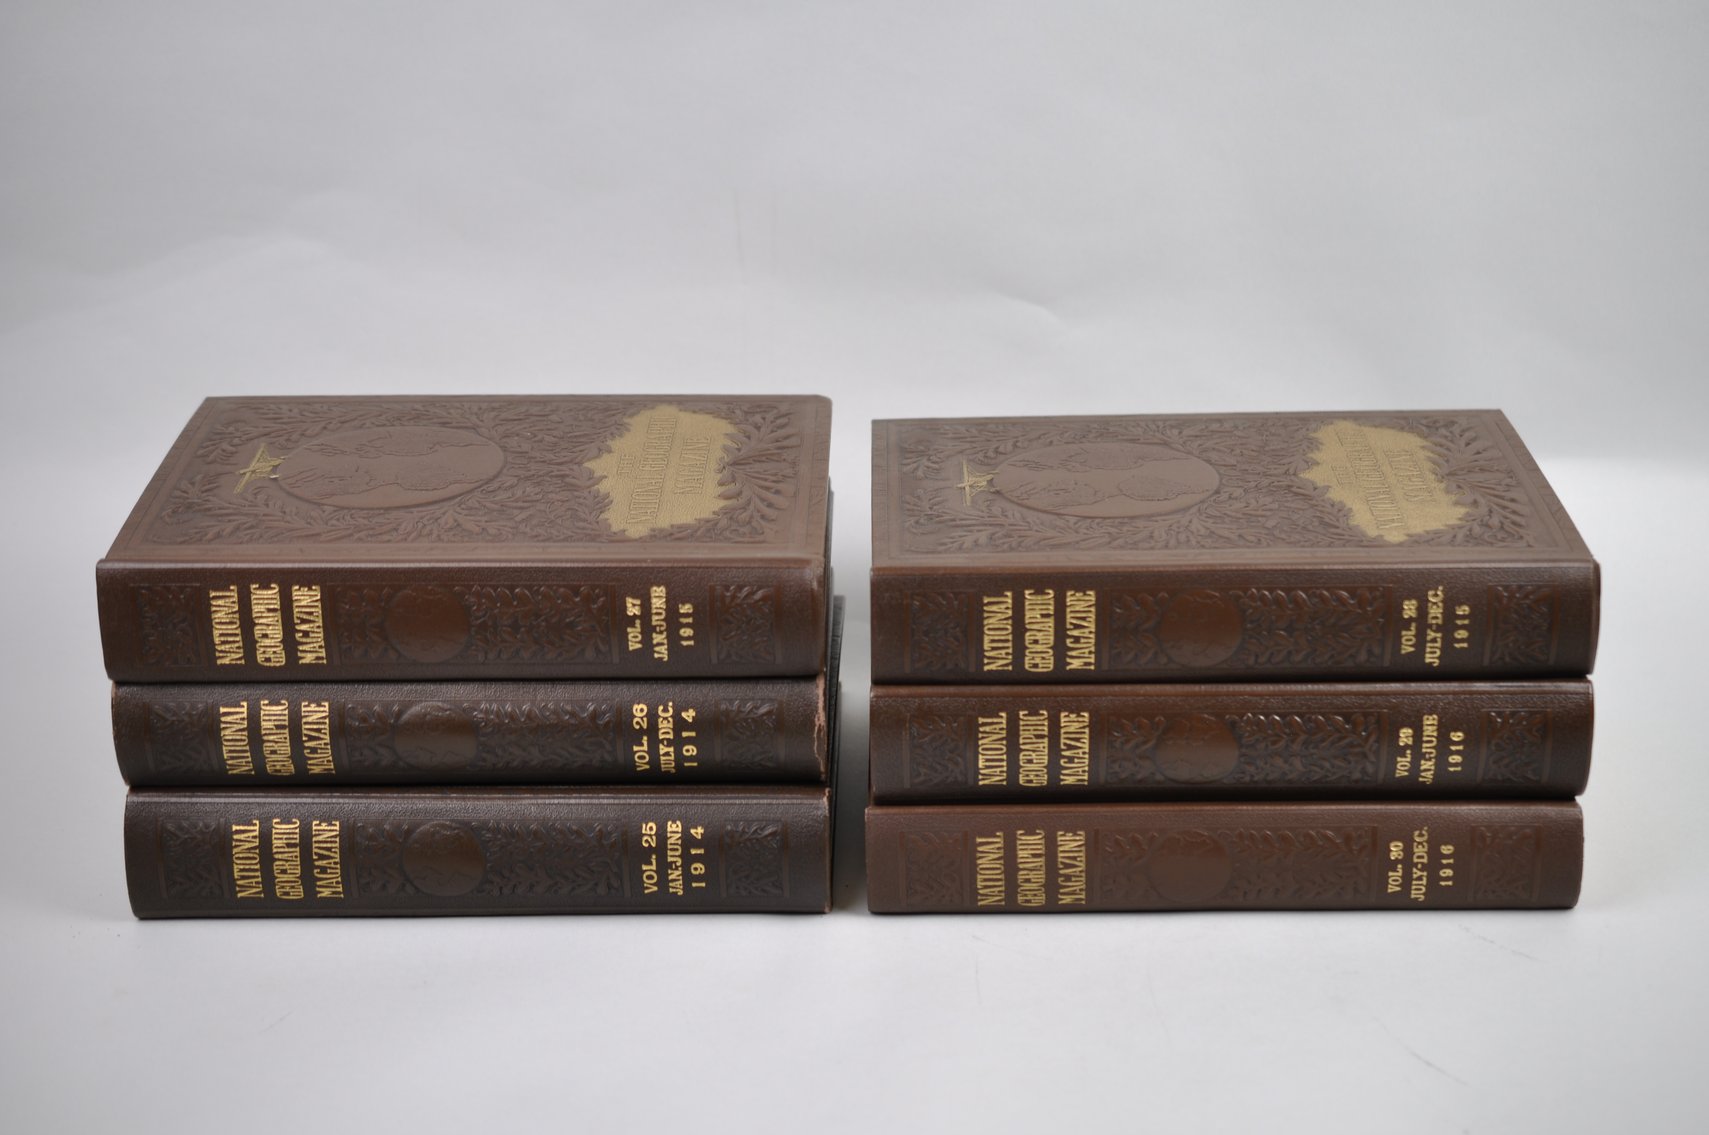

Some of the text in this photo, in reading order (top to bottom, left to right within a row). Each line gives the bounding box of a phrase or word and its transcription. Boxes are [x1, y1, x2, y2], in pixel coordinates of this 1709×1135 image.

[210, 585, 244, 665] NATIONAL
[250, 584, 286, 666] GEOGRAPHIC
[292, 585, 326, 664] MAGAZINE
[626, 597, 642, 651] VOL. 27
[679, 603, 694, 646] 1915
[983, 592, 1013, 671] NATIONAL
[1025, 589, 1055, 672] GEOGRAPHIC
[1067, 591, 1096, 670] MAGAZINE
[1401, 600, 1417, 654] VOL. 28
[1425, 586, 1444, 666] JULY-DEC.
[1454, 604, 1470, 648] 1915
[219, 701, 255, 775] NATIONAL
[261, 700, 295, 776] GEOGRAPHIC
[302, 702, 335, 774] MAGAZINE
[633, 703, 649, 771] VOL. 26
[658, 702, 676, 773] JULY-DEC.
[681, 709, 698, 767] 1914
[978, 712, 1007, 785] NATIONAL
[1019, 710, 1049, 787] GEOGRAPHIC
[1060, 711, 1089, 785] MAGAZINE
[1395, 727, 1413, 777] VOL. 29
[1448, 731, 1464, 772] 1916
[232, 820, 264, 898] NATIONAL
[272, 818, 304, 899] GEOGRAPHIC
[313, 820, 344, 898] MAGAZINE
[642, 822, 658, 893] VOL. 25
[690, 826, 706, 888] 1914
[976, 832, 1005, 906] NATIONAL
[1017, 830, 1046, 906] GEOGRAPHIC
[1057, 831, 1086, 904] MAGAZINE
[1388, 841, 1403, 893] VOL. 30
[1411, 826, 1428, 901] JULY-DEC.
[1440, 844, 1454, 886] 1916
